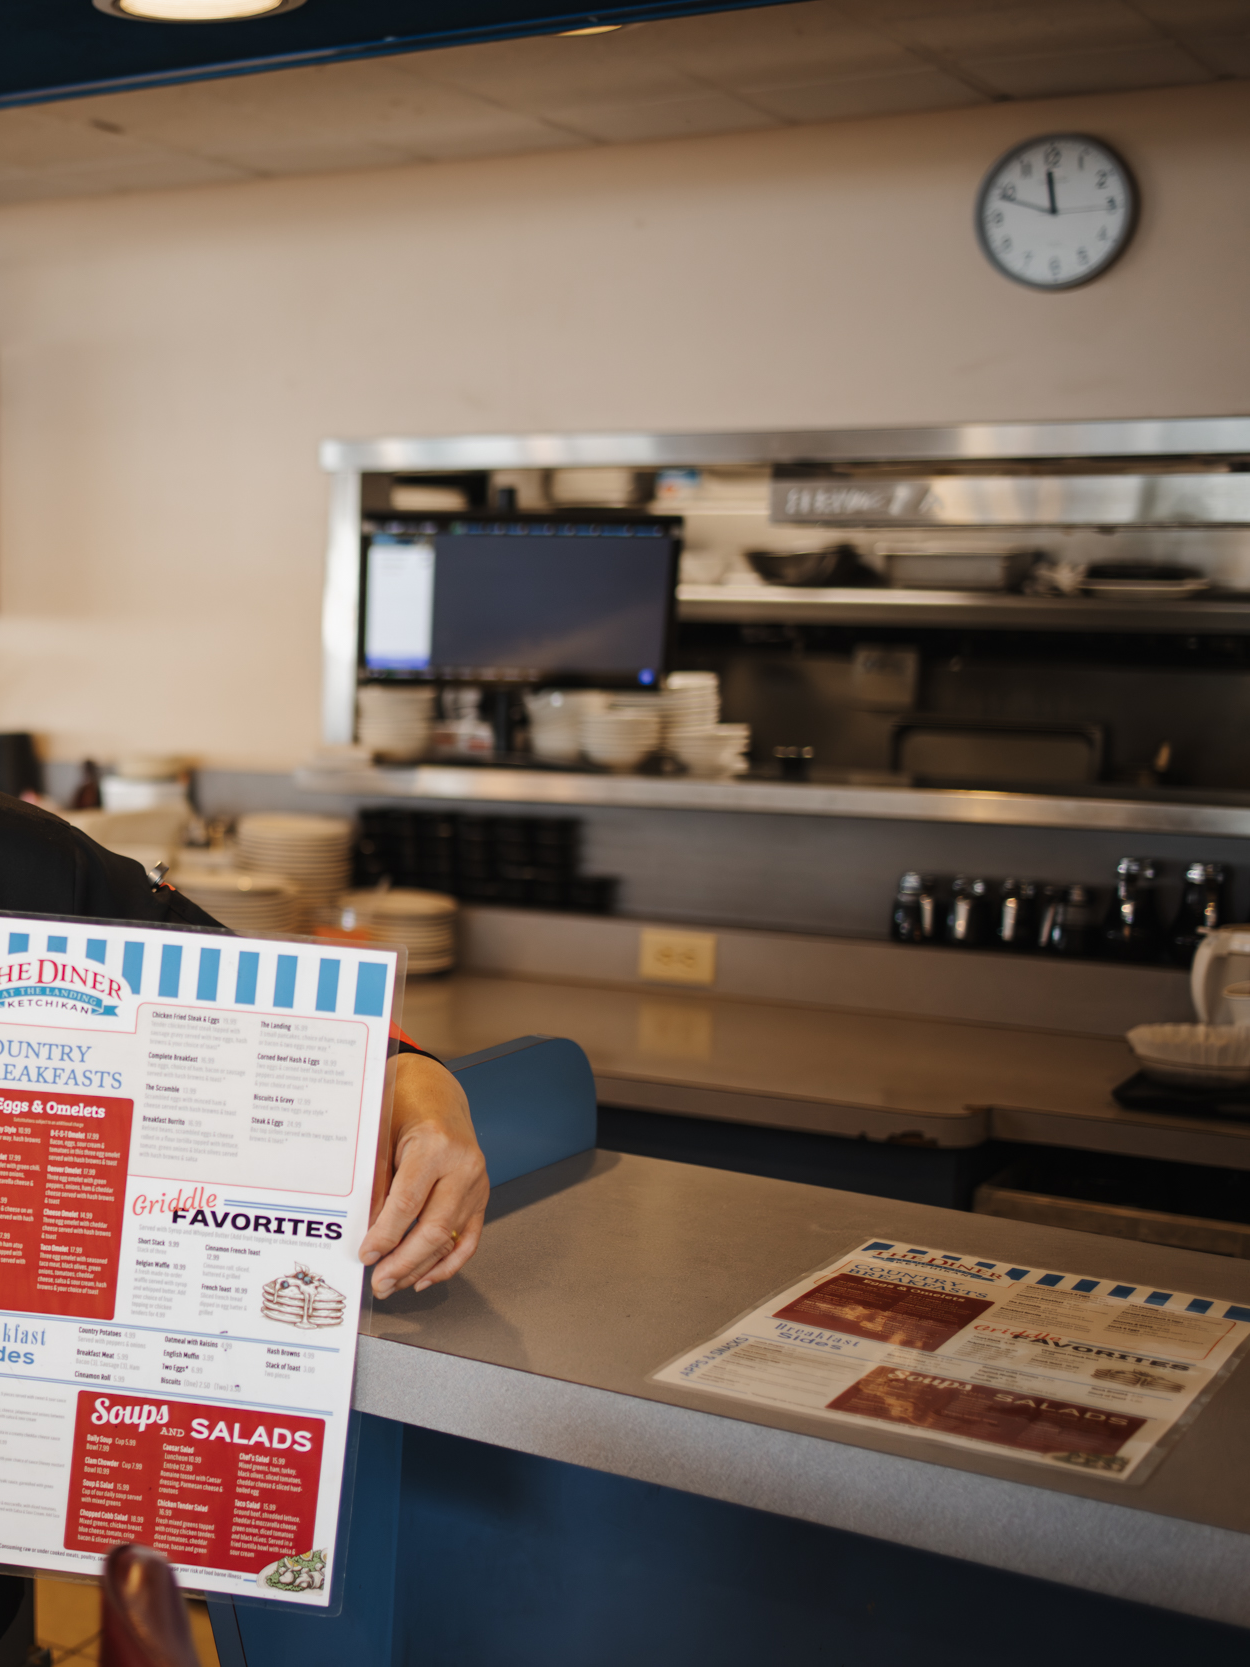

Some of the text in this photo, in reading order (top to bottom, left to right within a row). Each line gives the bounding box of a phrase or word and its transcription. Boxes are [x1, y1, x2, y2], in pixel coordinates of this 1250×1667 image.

[35, 959, 123, 1001] DINER
[1, 986, 97, 1005] AT THE LANDING
[7, 999, 90, 1014] KETCHIKAN
[151, 1010, 172, 1018] Chicken
[173, 1012, 186, 1020] Fried
[207, 1015, 220, 1024] Eggs
[270, 1021, 291, 1030] Landing
[148, 1051, 198, 1062] Complete Breakfast
[257, 1052, 275, 1060] Corned
[276, 1054, 288, 1062] Beef
[288, 1055, 302, 1063] Hash
[307, 1057, 320, 1066] Eggs
[155, 1084, 180, 1093] Scramble
[253, 1093, 274, 1101] Biscuits
[279, 1096, 294, 1104] Gravy
[31, 1100, 43, 1113] &
[46, 1101, 105, 1118] Omelets
[142, 1115, 185, 1125] Breakfast Burrito
[251, 1116, 265, 1124] Steak
[271, 1118, 283, 1127] Eggs
[132, 1186, 217, 1216] Griddle
[171, 1207, 343, 1240] FAVORITES
[137, 1237, 151, 1245] Short
[151, 1238, 165, 1246] Stack
[204, 1244, 260, 1256] Cinnamon French Toast
[135, 1259, 153, 1268] Belgian
[874, 1250, 1002, 1280] THE DINER
[854, 1264, 965, 1288] COUNTRY
[201, 1283, 218, 1291] French
[218, 1285, 231, 1293] Toast
[848, 1268, 988, 1298] BREAKFASTS
[78, 1326, 121, 1337] Country Potatoes
[775, 1322, 860, 1348] Breakfast
[973, 1324, 1062, 1342] Griddle
[164, 1335, 218, 1348] Oatmeal with Raisins
[777, 1331, 843, 1350] Sides
[76, 1348, 114, 1359] Breakfast Meat
[163, 1349, 199, 1360] English Muffin
[266, 1347, 300, 1358] Hash Browns
[680, 1336, 749, 1377] APPS & SNACKS
[1011, 1334, 1191, 1371] FAVORITES
[161, 1362, 172, 1370] Two
[265, 1360, 300, 1372] Stack of Toast
[74, 1370, 111, 1381] Cinnamon Roll
[160, 1376, 181, 1385] Biscuits
[887, 1369, 973, 1392] Soups
[91, 1397, 169, 1432] Soups
[993, 1393, 1129, 1426] SALADS
[86, 1434, 99, 1443] Daily
[99, 1435, 113, 1445] Soup
[114, 1437, 125, 1446] Cup
[160, 1418, 312, 1452] AND SALADS
[85, 1443, 98, 1451] Bowl
[162, 1443, 194, 1454] Caesar Salad
[84, 1456, 97, 1464] Clam
[97, 1457, 119, 1467] Chowder
[121, 1460, 132, 1469] Cup
[164, 1452, 188, 1462] Luncheon
[254, 1454, 269, 1464] Salad
[83, 1465, 96, 1473] Bowl
[163, 1461, 179, 1470] Entrée
[82, 1479, 95, 1488] Soup
[99, 1481, 114, 1489] Salad
[157, 1499, 208, 1513] Chicken Tender Salad
[234, 1499, 246, 1508] Taco
[245, 1500, 260, 1510] Salad
[79, 1509, 101, 1519] Chopped
[100, 1511, 113, 1519] Cobb
[113, 1513, 128, 1521] Salad
